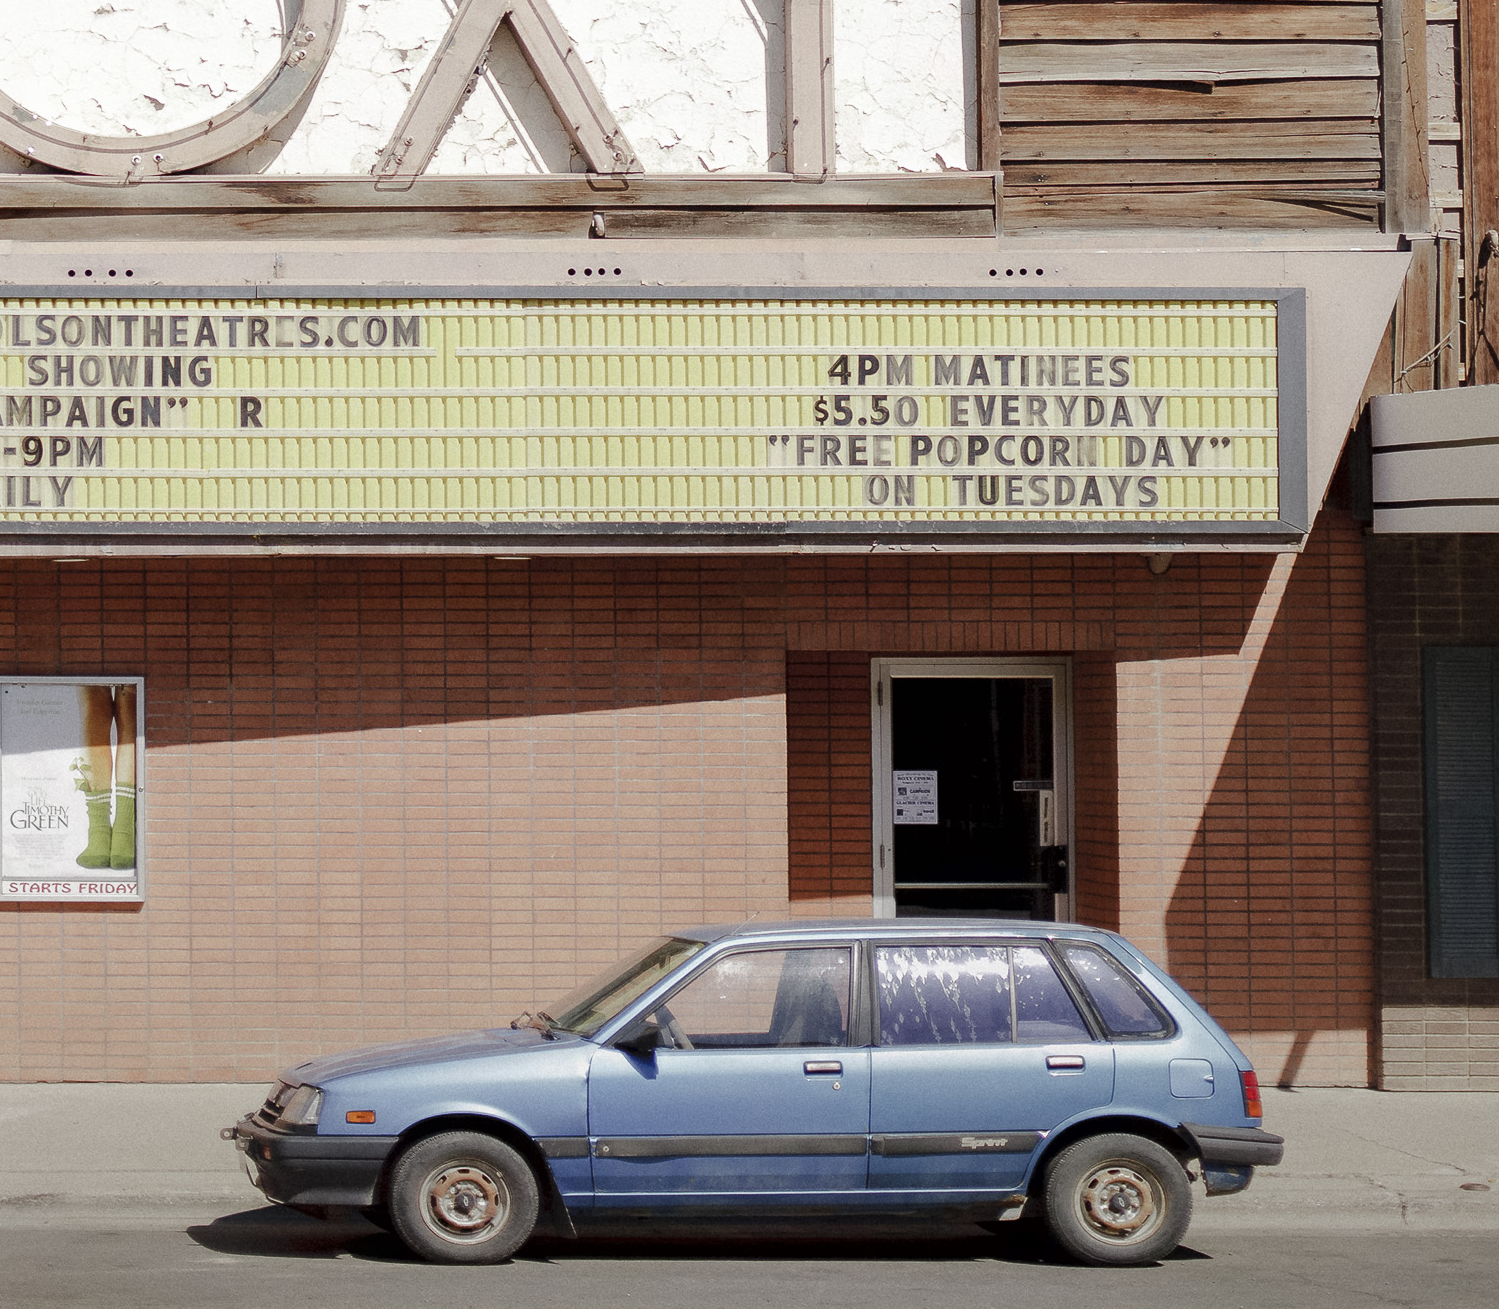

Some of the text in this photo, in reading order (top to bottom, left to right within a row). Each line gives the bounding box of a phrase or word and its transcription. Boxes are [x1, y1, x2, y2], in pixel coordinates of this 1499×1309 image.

[28, 355, 214, 389] SHOWING
[827, 354, 1132, 388] 4PM MATINEES
[238, 397, 265, 429] R
[813, 394, 1165, 428] $5.50 EVERYDAY
[910, 434, 1098, 468] POPCORN
[1125, 435, 1232, 468] DAY"
[866, 475, 1160, 508] ON TUESDAYS
[10, 809, 69, 831] GREEN
[21, 801, 70, 819] TIMOTHY
[9, 882, 138, 894] STARTS FRIDAY
